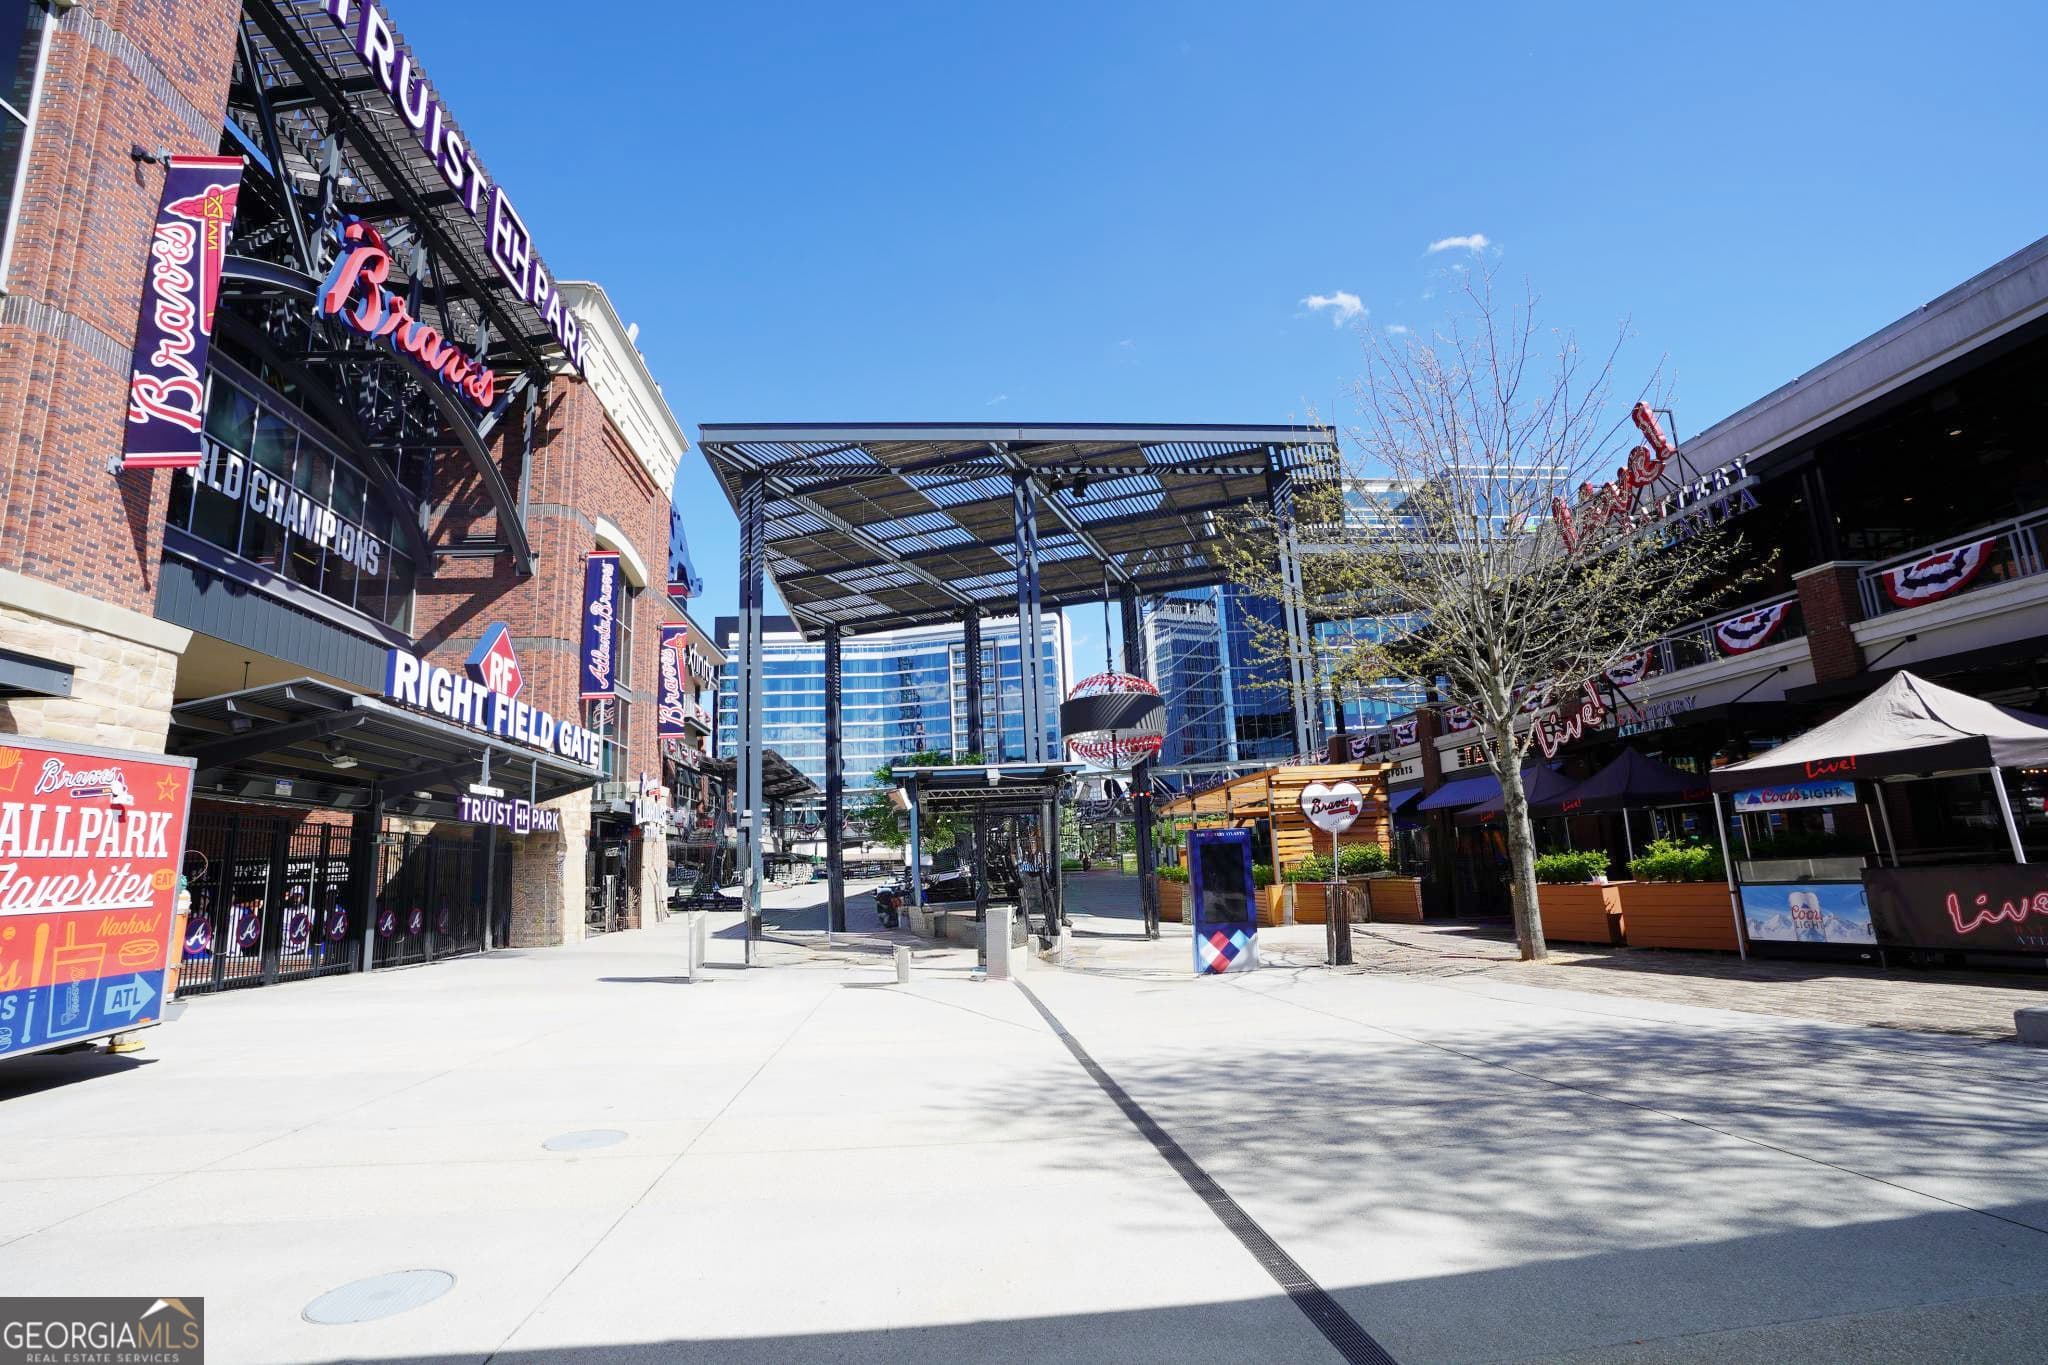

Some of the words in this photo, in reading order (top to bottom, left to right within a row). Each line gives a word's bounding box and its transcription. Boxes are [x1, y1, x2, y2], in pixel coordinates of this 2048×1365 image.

[129, 221, 204, 434] Braves
[319, 214, 495, 408] Braves
[533, 262, 591, 376] PARK
[249, 469, 381, 577] CHAMPIONS
[489, 651, 517, 696] RF
[588, 620, 612, 690] Atlanta
[387, 649, 492, 729] RIGHT
[492, 692, 554, 755] FIELD
[557, 719, 600, 770] GATE
[658, 648, 685, 728] Braves
[1533, 680, 1606, 758] Live!
[35, 757, 122, 796] Braves
[1386, 765, 1413, 779] PORTS
[1804, 754, 1857, 779] Live!
[461, 796, 513, 827] TRUIST
[531, 808, 560, 832] PARK
[1801, 786, 1844, 801] LIGHT
[155, 873, 174, 887] EAT
[97, 912, 163, 938] Nachos!
[112, 987, 141, 1010] ATL
